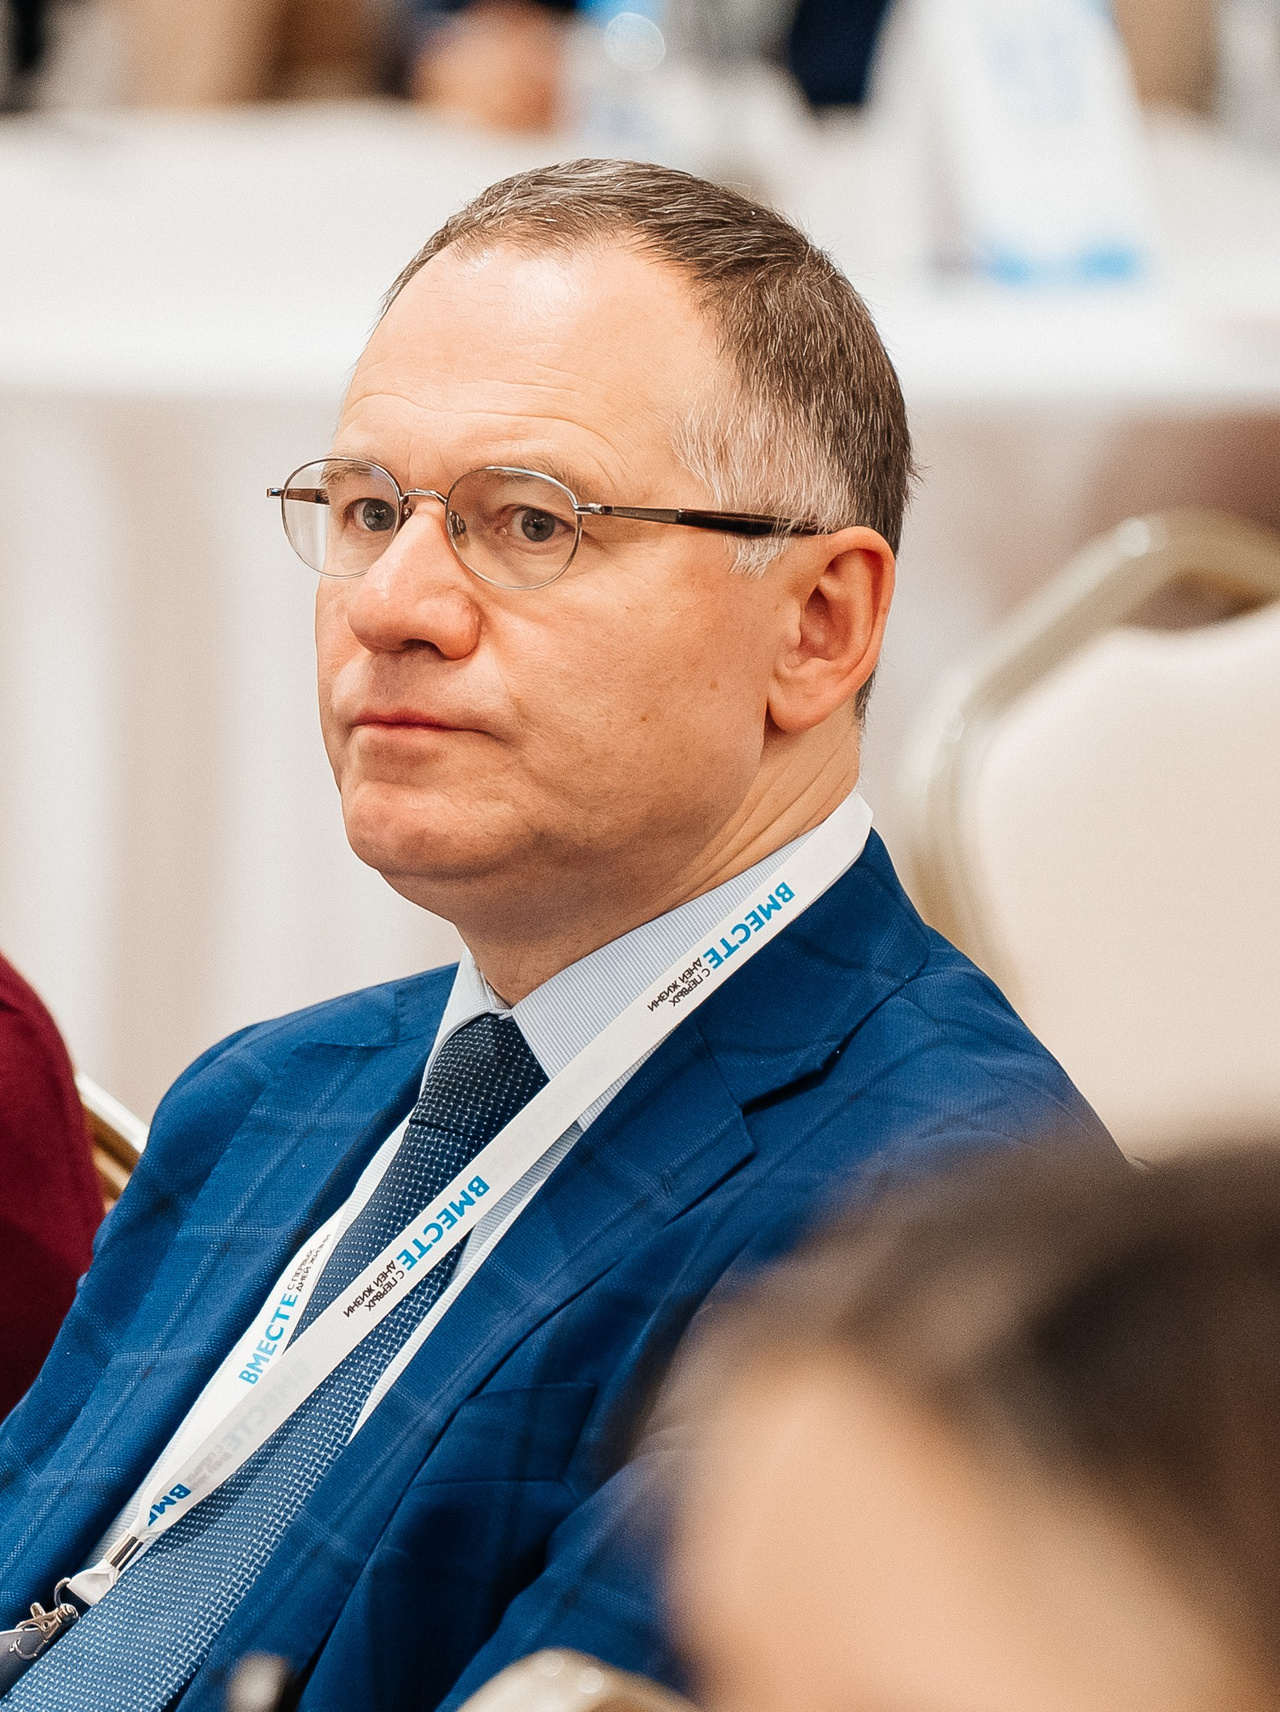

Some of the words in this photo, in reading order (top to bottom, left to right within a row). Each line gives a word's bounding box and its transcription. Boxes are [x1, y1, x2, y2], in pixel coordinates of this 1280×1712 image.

[703, 881, 795, 969] ВМЕСТЕ
[678, 957, 703, 985] ДНЕЙ
[701, 968, 711, 978] С
[647, 980, 681, 1012] ЖИЗНИ
[668, 974, 704, 1007] ПЕРВЫХ
[396, 1175, 490, 1271] ВМЕСТЕ
[372, 1260, 396, 1288] ДНЕЙ
[395, 1270, 405, 1280] С
[343, 1284, 375, 1318] ЖИЗНИ
[364, 1277, 398, 1311] ПЕРВЫХ
[238, 1293, 298, 1385] ВМЕСТЕ
